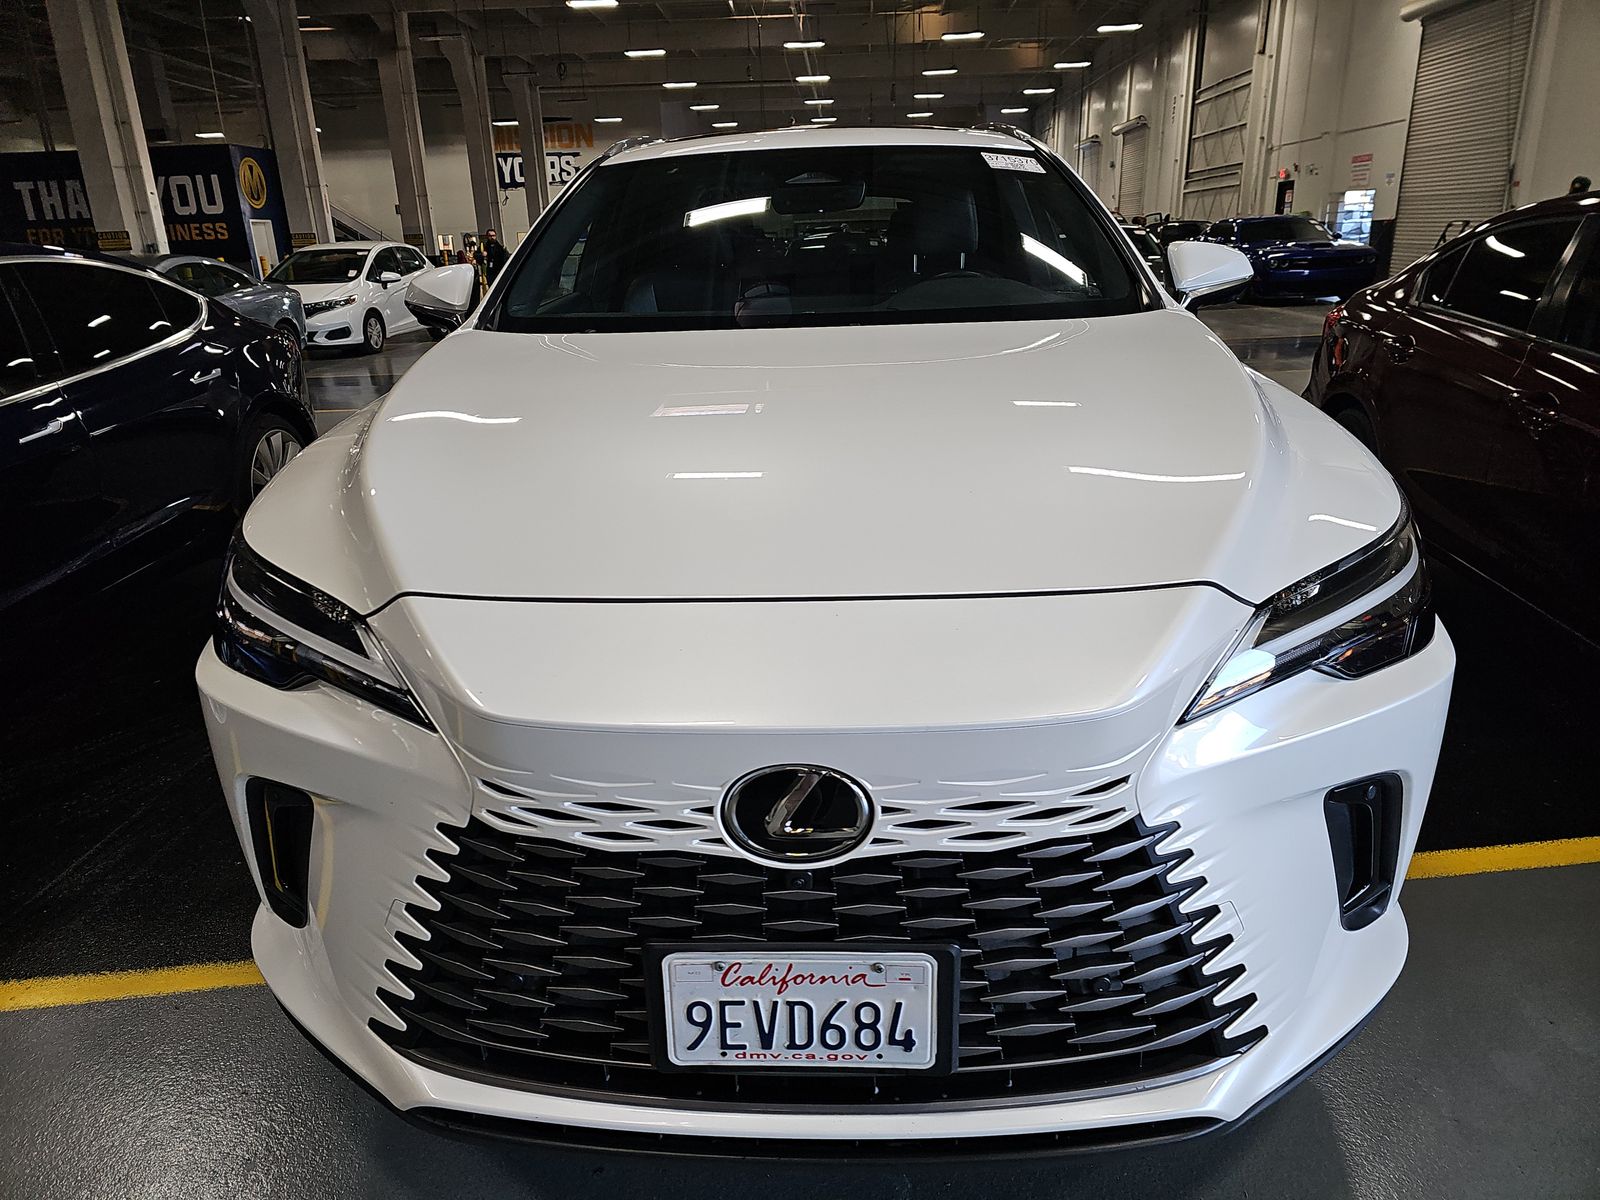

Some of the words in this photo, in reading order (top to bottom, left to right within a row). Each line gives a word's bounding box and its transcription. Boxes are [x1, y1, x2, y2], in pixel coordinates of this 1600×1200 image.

[497, 155, 576, 183] YORS
[97, 231, 128, 240] CAUTION
[719, 962, 887, 995] California
[685, 1000, 917, 1052] 9EVD684
[734, 1051, 868, 1061] dmv.ca.gov
